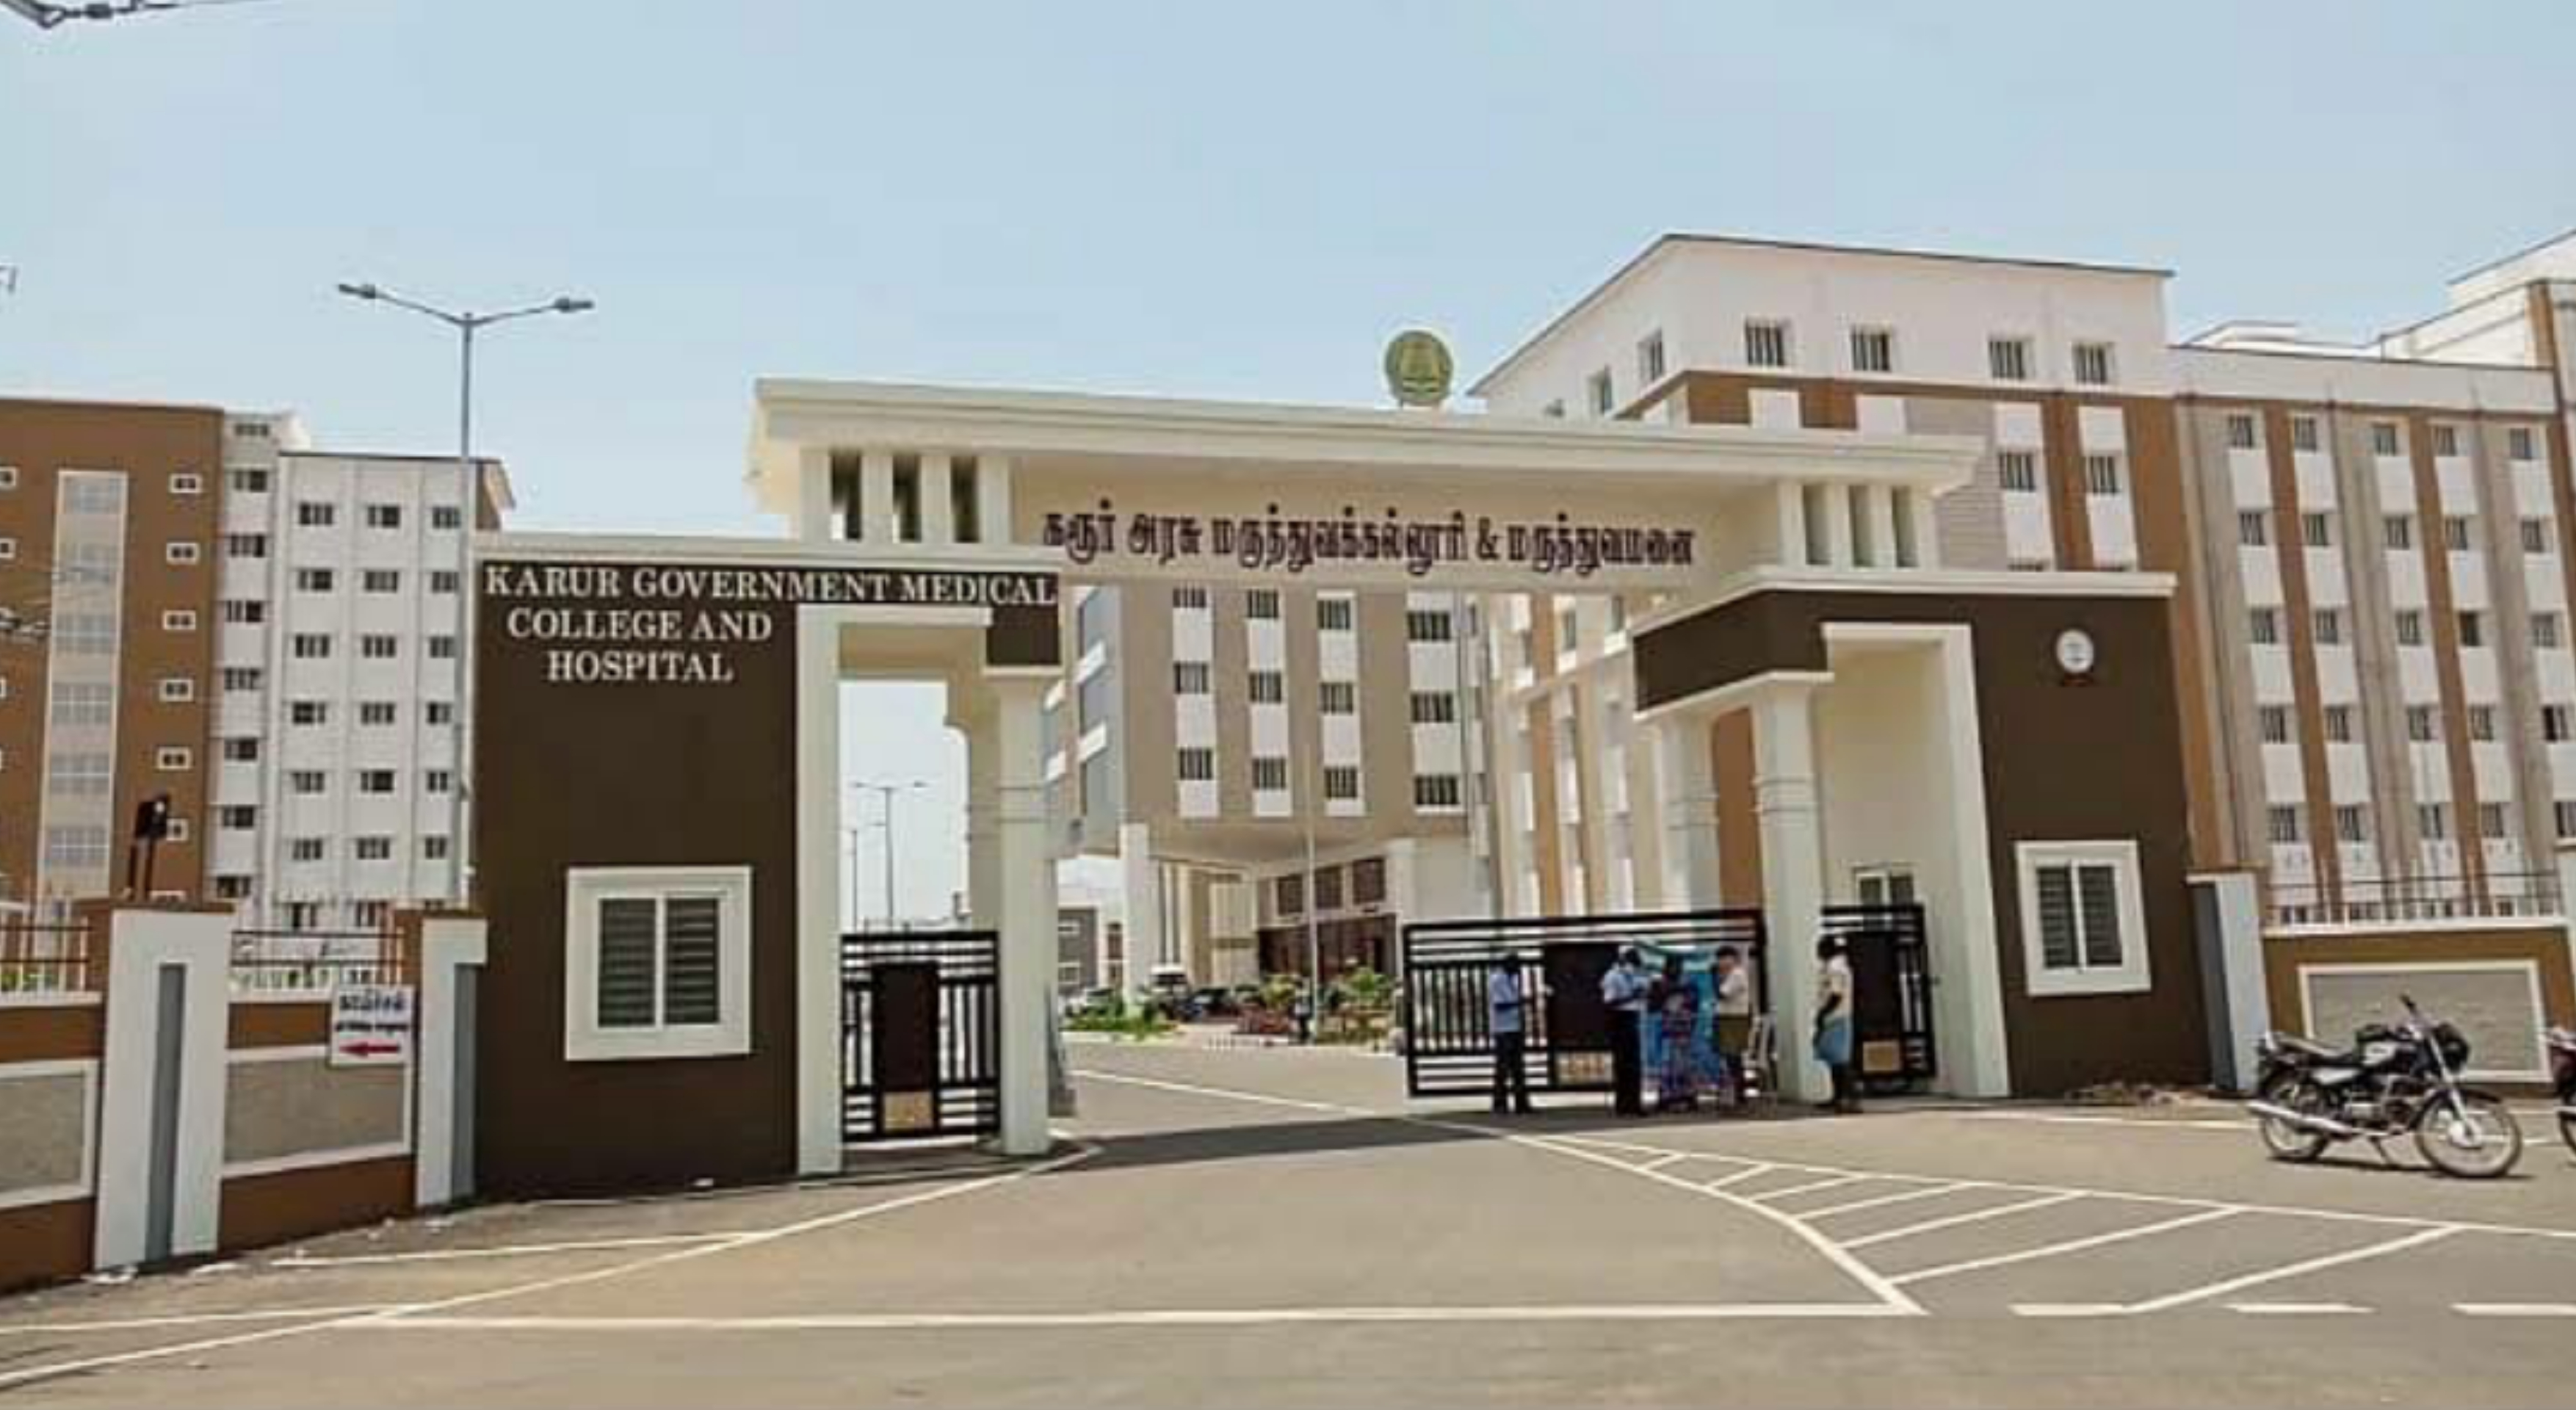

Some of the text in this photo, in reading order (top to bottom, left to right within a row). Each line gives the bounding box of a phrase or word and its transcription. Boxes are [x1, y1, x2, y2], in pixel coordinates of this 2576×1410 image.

[1043, 497, 1695, 578] கரூர் அரசு மருத்துவக்கல்லூரி & மருத்துவமனை
[485, 567, 1059, 605] KARUR GOVERNMENT MEDICAL
[507, 609, 773, 641] COLLEGE AND
[547, 651, 733, 682] HOSPITAL
